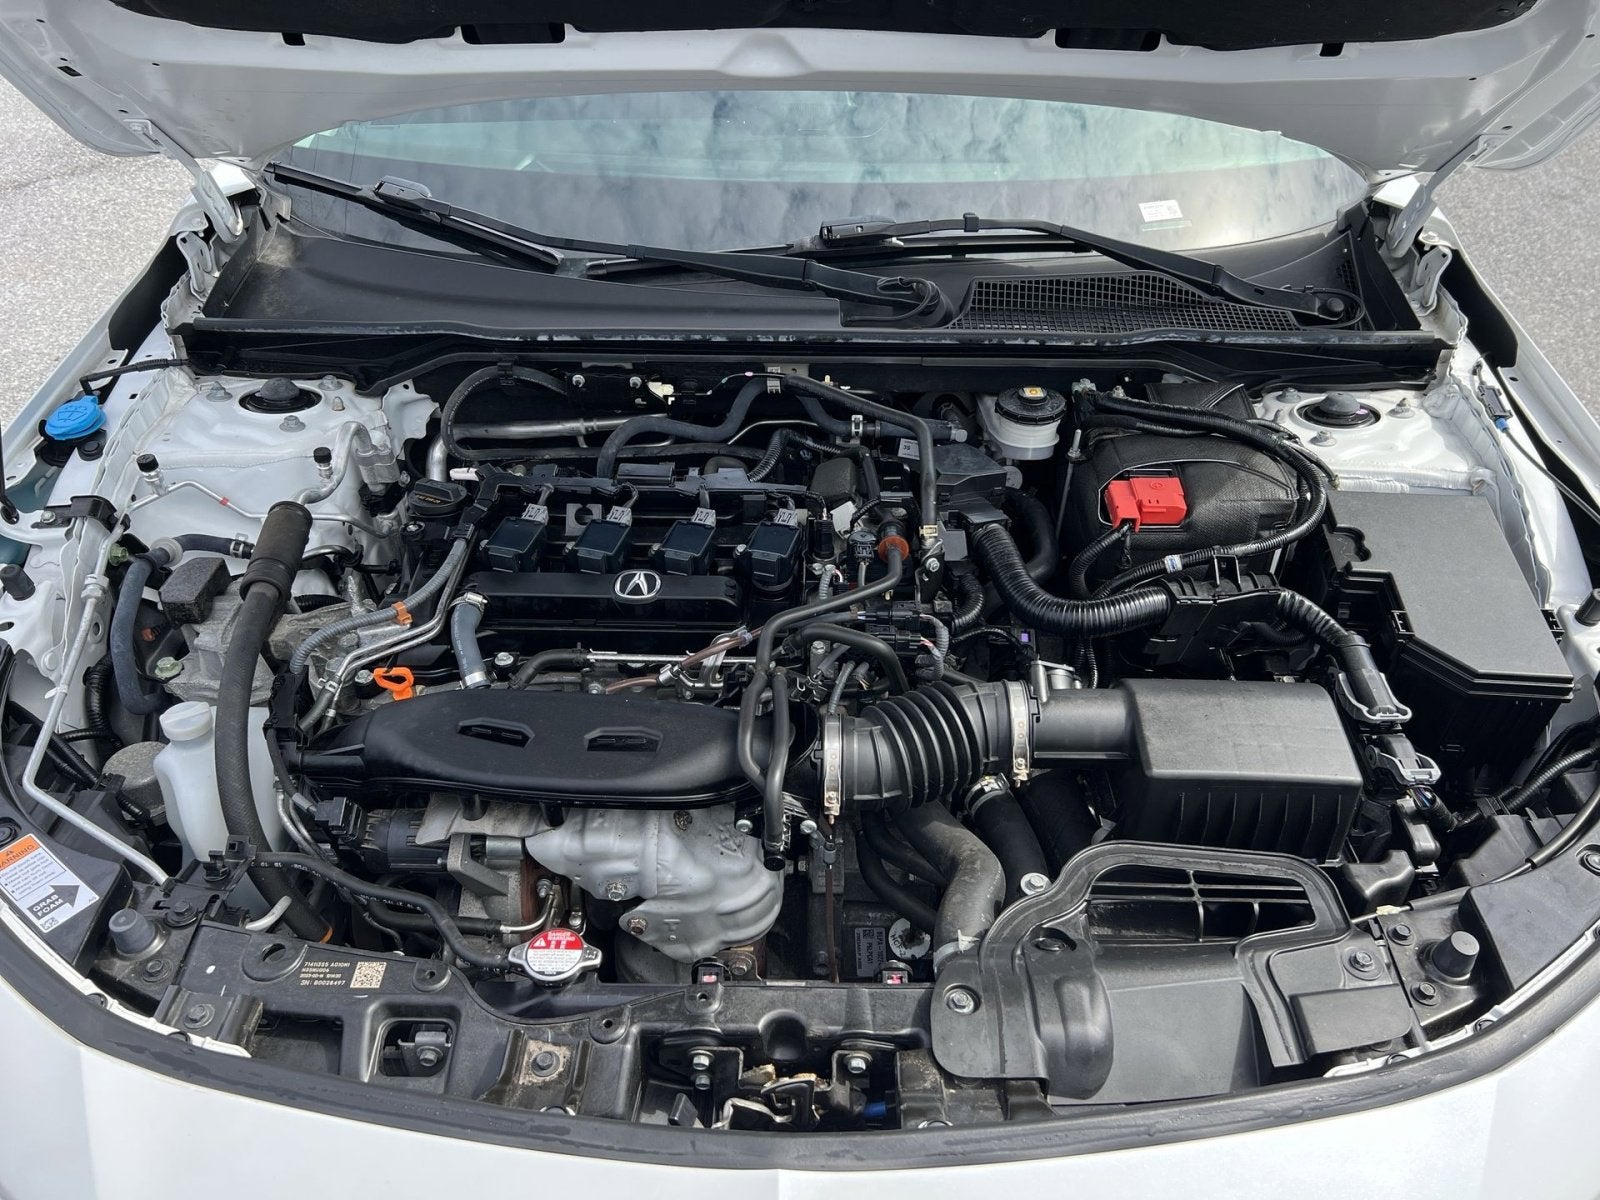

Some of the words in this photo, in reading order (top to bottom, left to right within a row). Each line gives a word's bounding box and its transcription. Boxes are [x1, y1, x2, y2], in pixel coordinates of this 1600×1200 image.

[0, 844, 34, 868] ARNING
[32, 893, 59, 912] GRAB
[37, 898, 64, 917] FOAM
